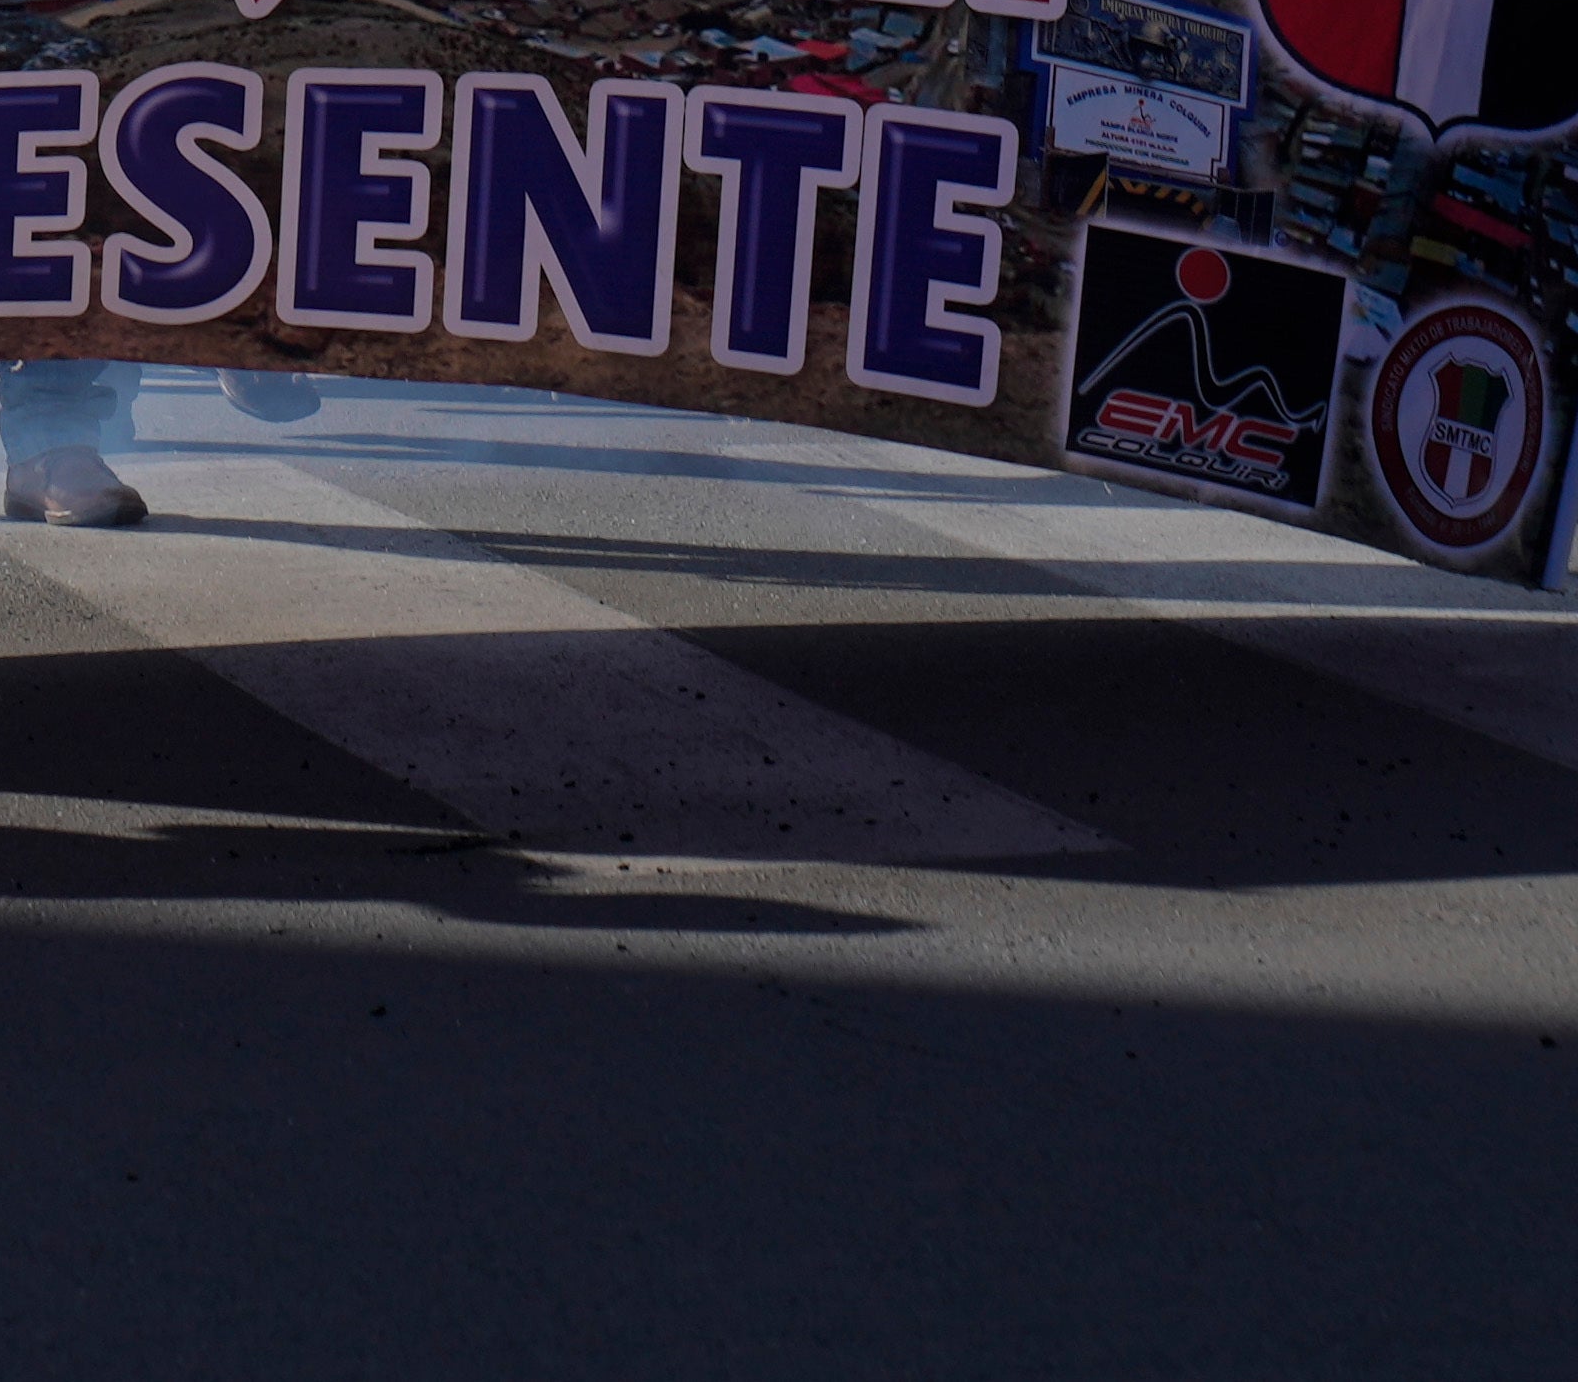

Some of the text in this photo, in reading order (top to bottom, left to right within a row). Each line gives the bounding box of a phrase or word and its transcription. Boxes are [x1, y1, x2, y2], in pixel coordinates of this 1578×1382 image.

[1066, 85, 1211, 139] EMPRESA MINERA COLQUIRI
[1095, 388, 1299, 467] EMC
[1433, 423, 1492, 454] SMTMC
